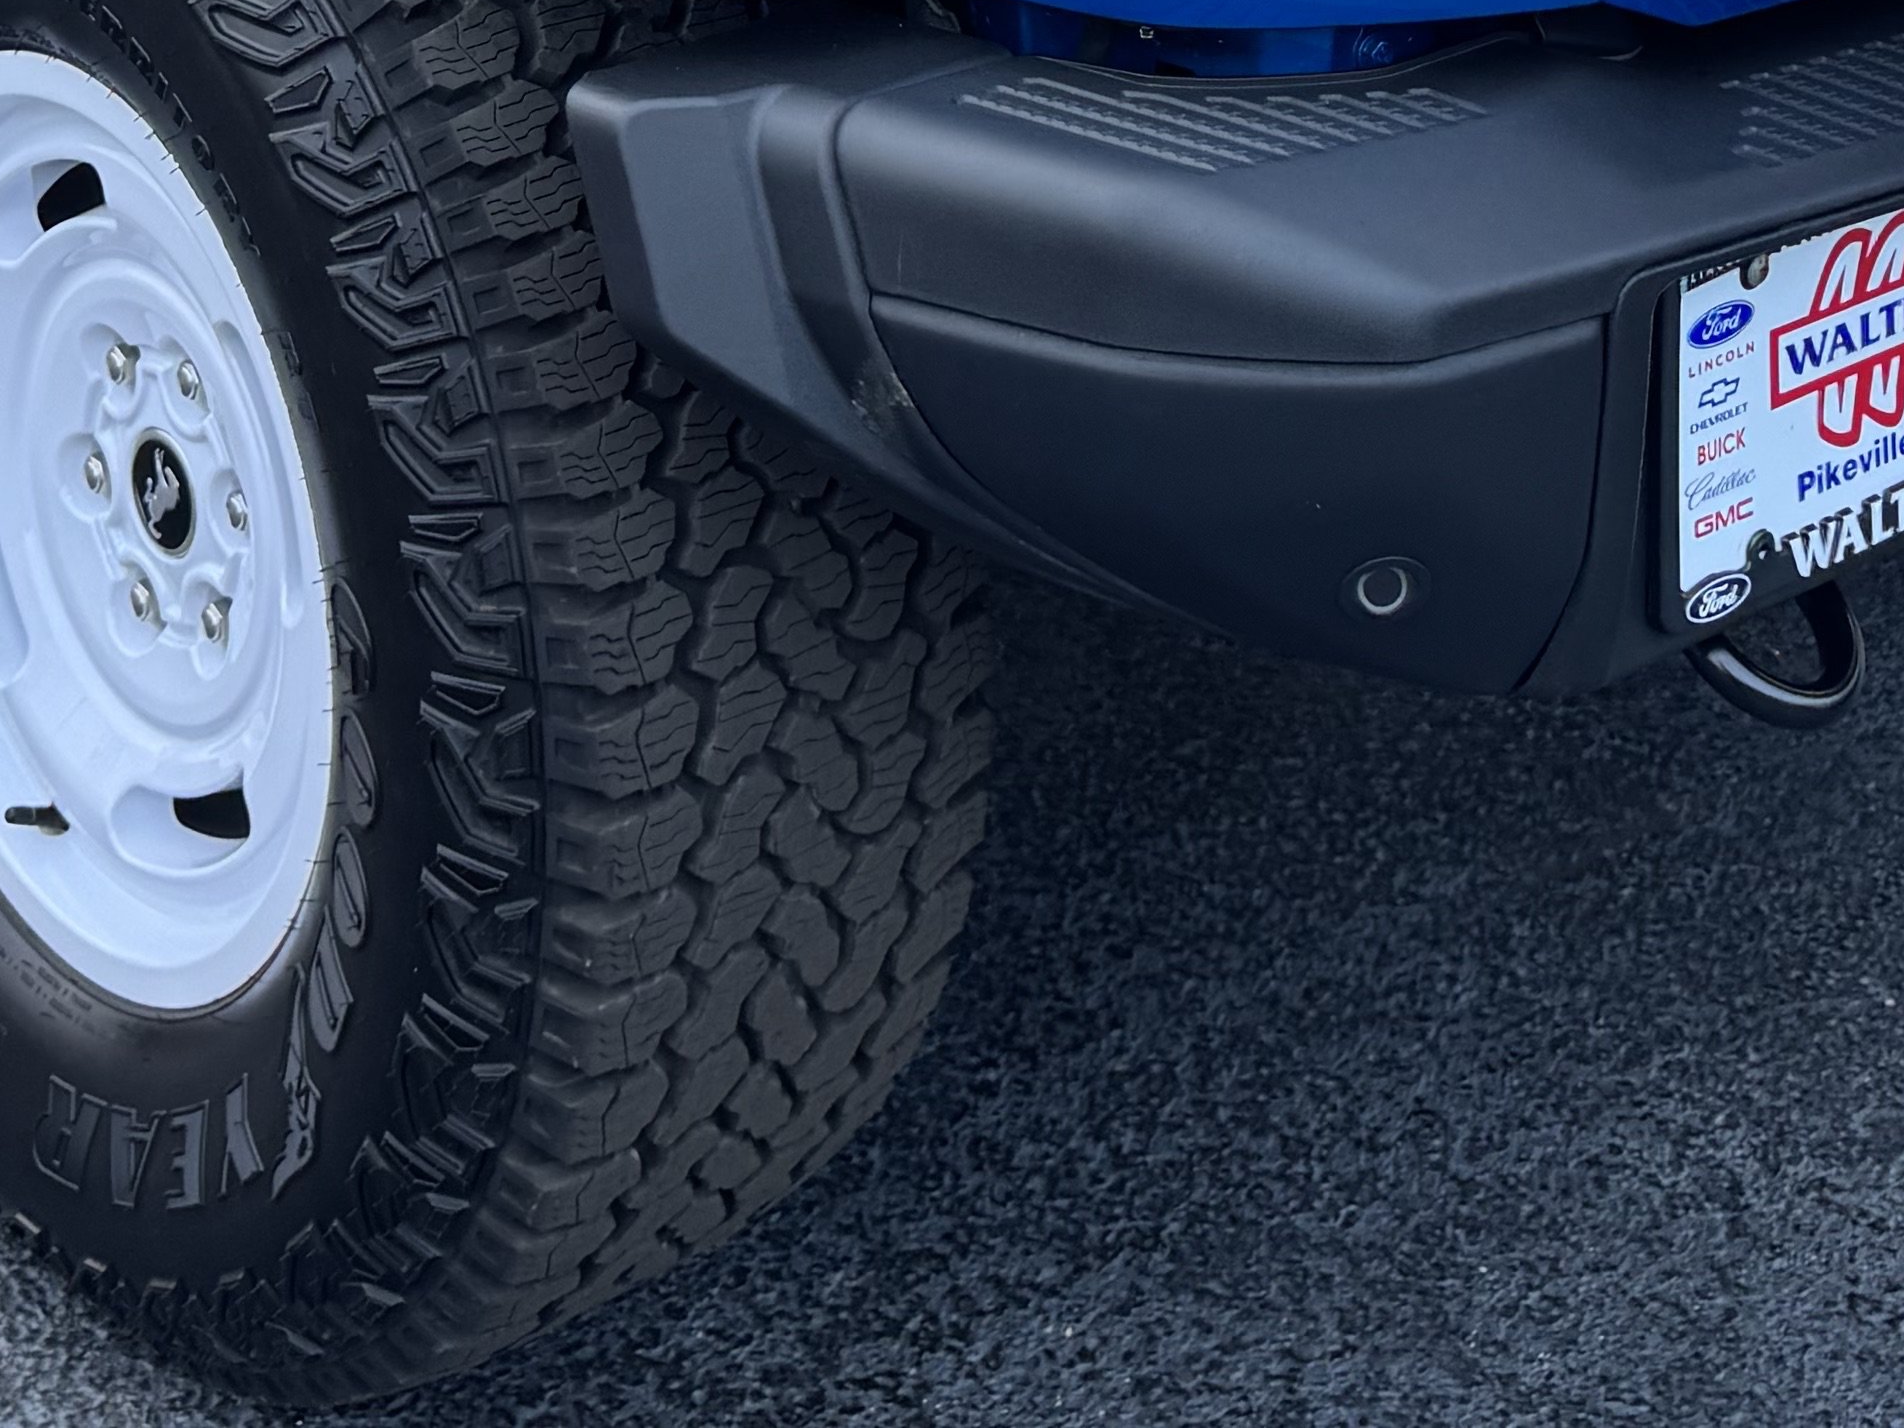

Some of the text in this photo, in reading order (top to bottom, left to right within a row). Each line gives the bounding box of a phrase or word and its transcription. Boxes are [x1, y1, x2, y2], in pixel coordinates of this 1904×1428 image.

[1701, 306, 1742, 341] Ford
[1687, 340, 1756, 379] LINCOLN
[1689, 402, 1749, 435] CHEVROLET
[1697, 428, 1747, 467] BUICK
[1684, 468, 1756, 511] Cadillac
[1693, 497, 1755, 539] GMC
[1698, 581, 1738, 617] Ford
